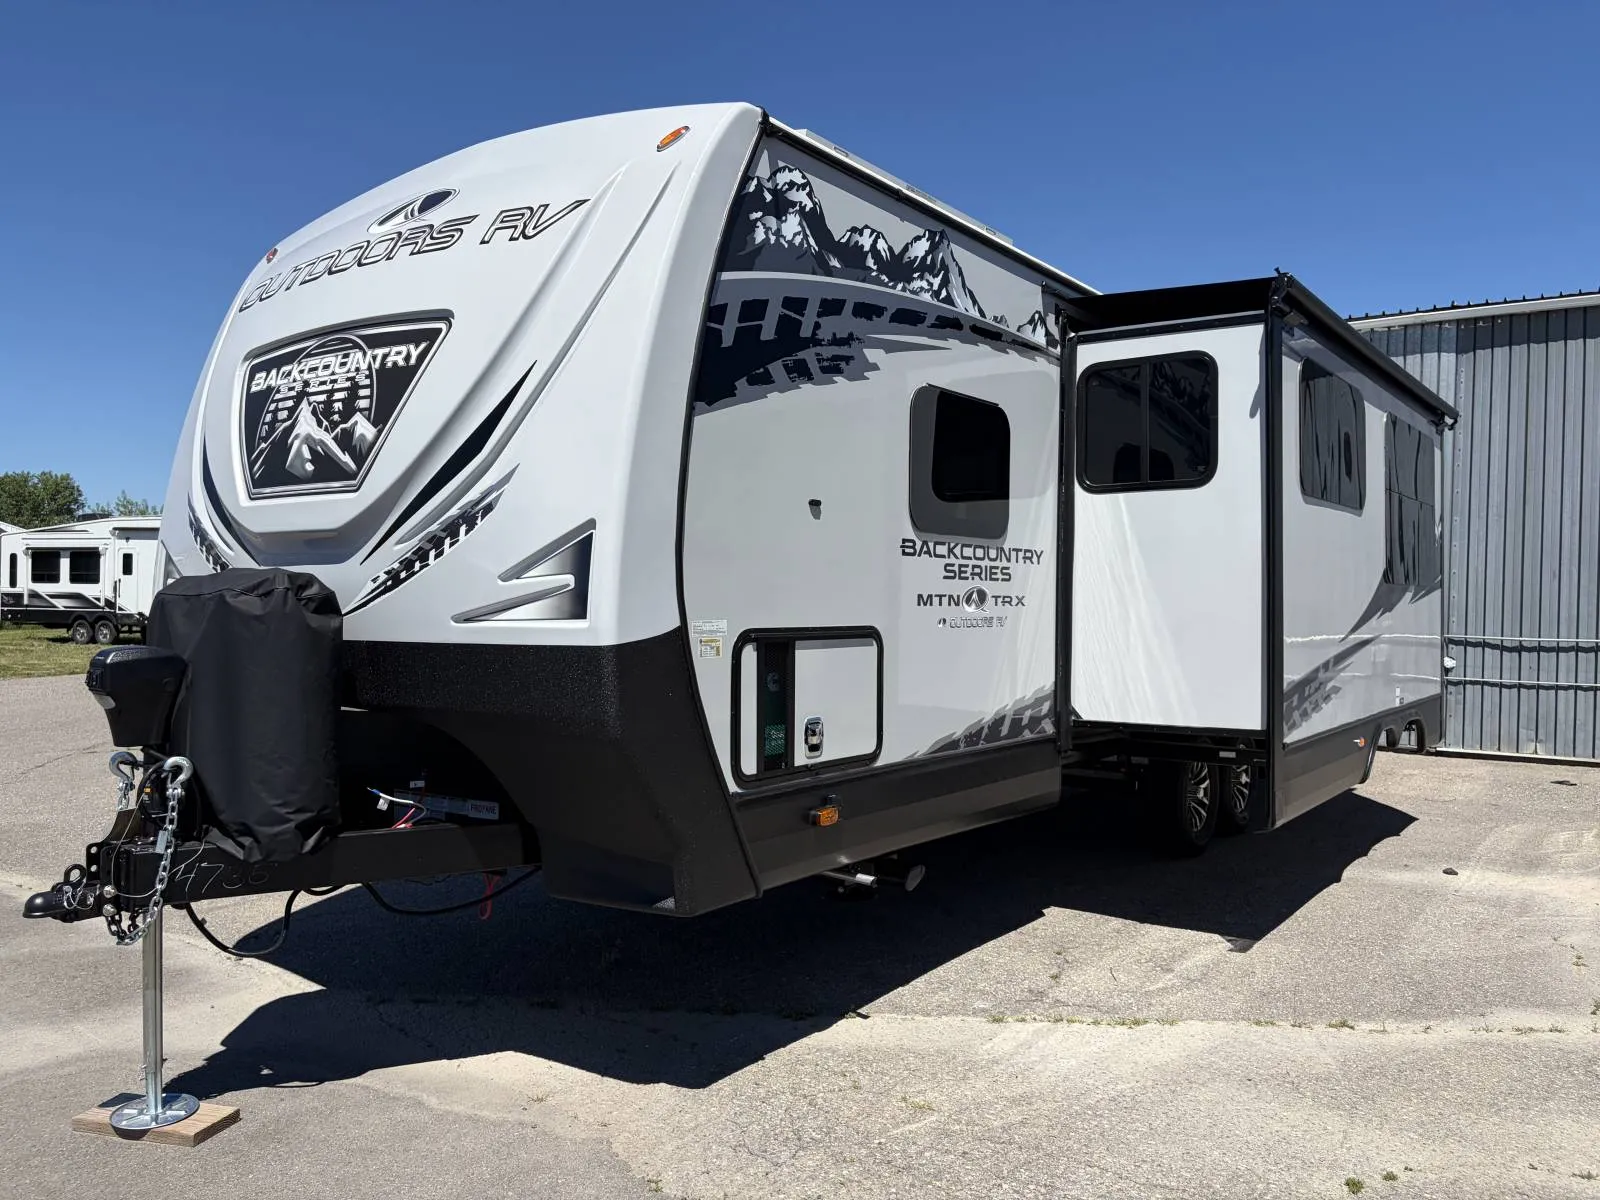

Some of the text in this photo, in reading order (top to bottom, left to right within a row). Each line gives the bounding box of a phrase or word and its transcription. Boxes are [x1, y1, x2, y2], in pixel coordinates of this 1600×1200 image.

[239, 199, 592, 313] OUTDOORS RV
[250, 341, 430, 393] BACKCOUNTRY
[279, 371, 367, 395] SERIES
[900, 538, 1044, 565] BACKCOUNTRY
[943, 563, 1012, 582] SERIES
[917, 594, 1026, 607] MTN TRX
